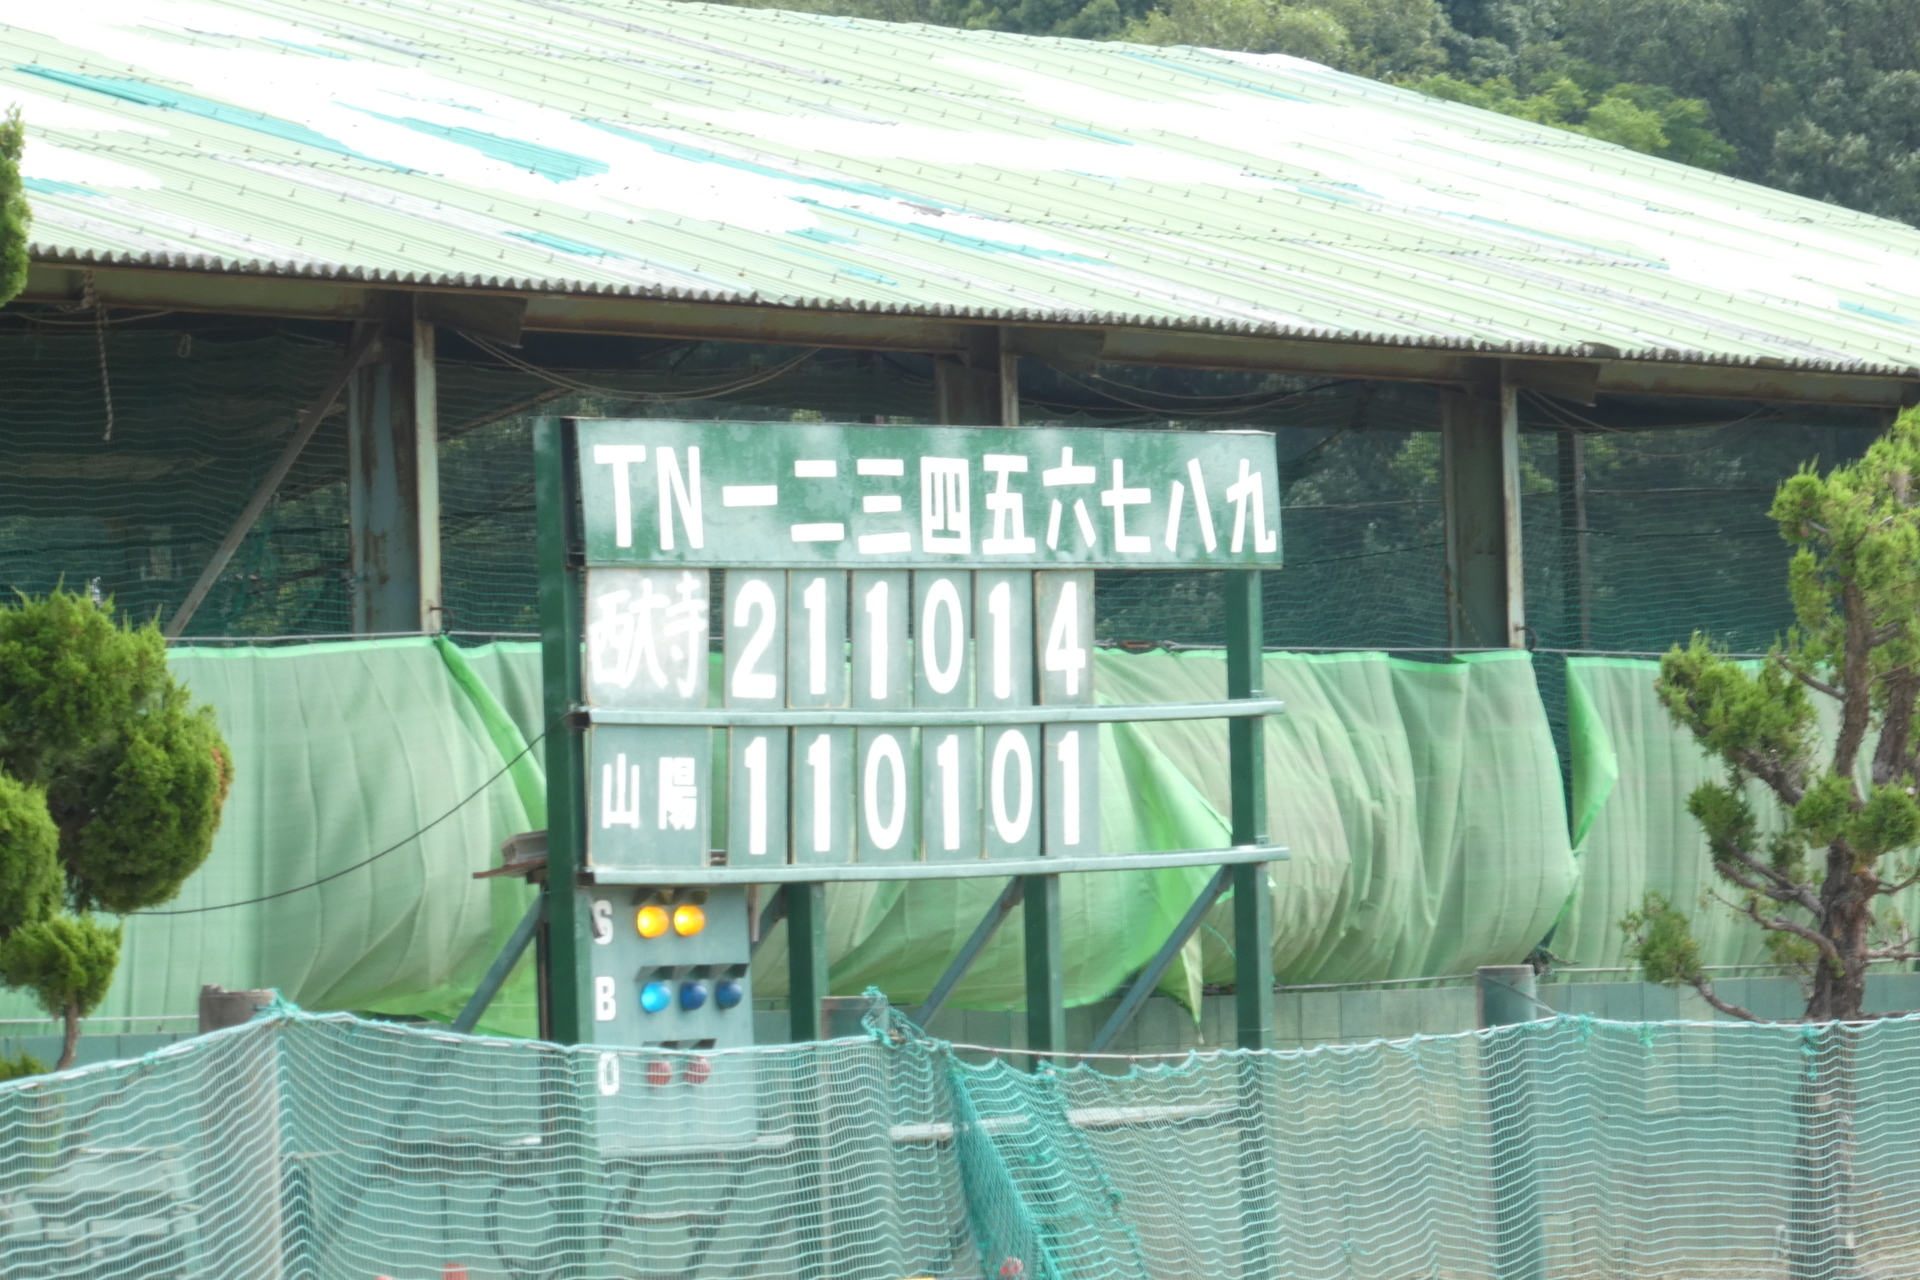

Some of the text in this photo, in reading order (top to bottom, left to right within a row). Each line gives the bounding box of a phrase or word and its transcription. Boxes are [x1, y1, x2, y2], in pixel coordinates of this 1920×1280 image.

[594, 444, 704, 550] TN
[588, 570, 709, 698] 西大寺
[602, 753, 697, 830] 山陽
[591, 900, 613, 945] S
[595, 976, 616, 1021] B
